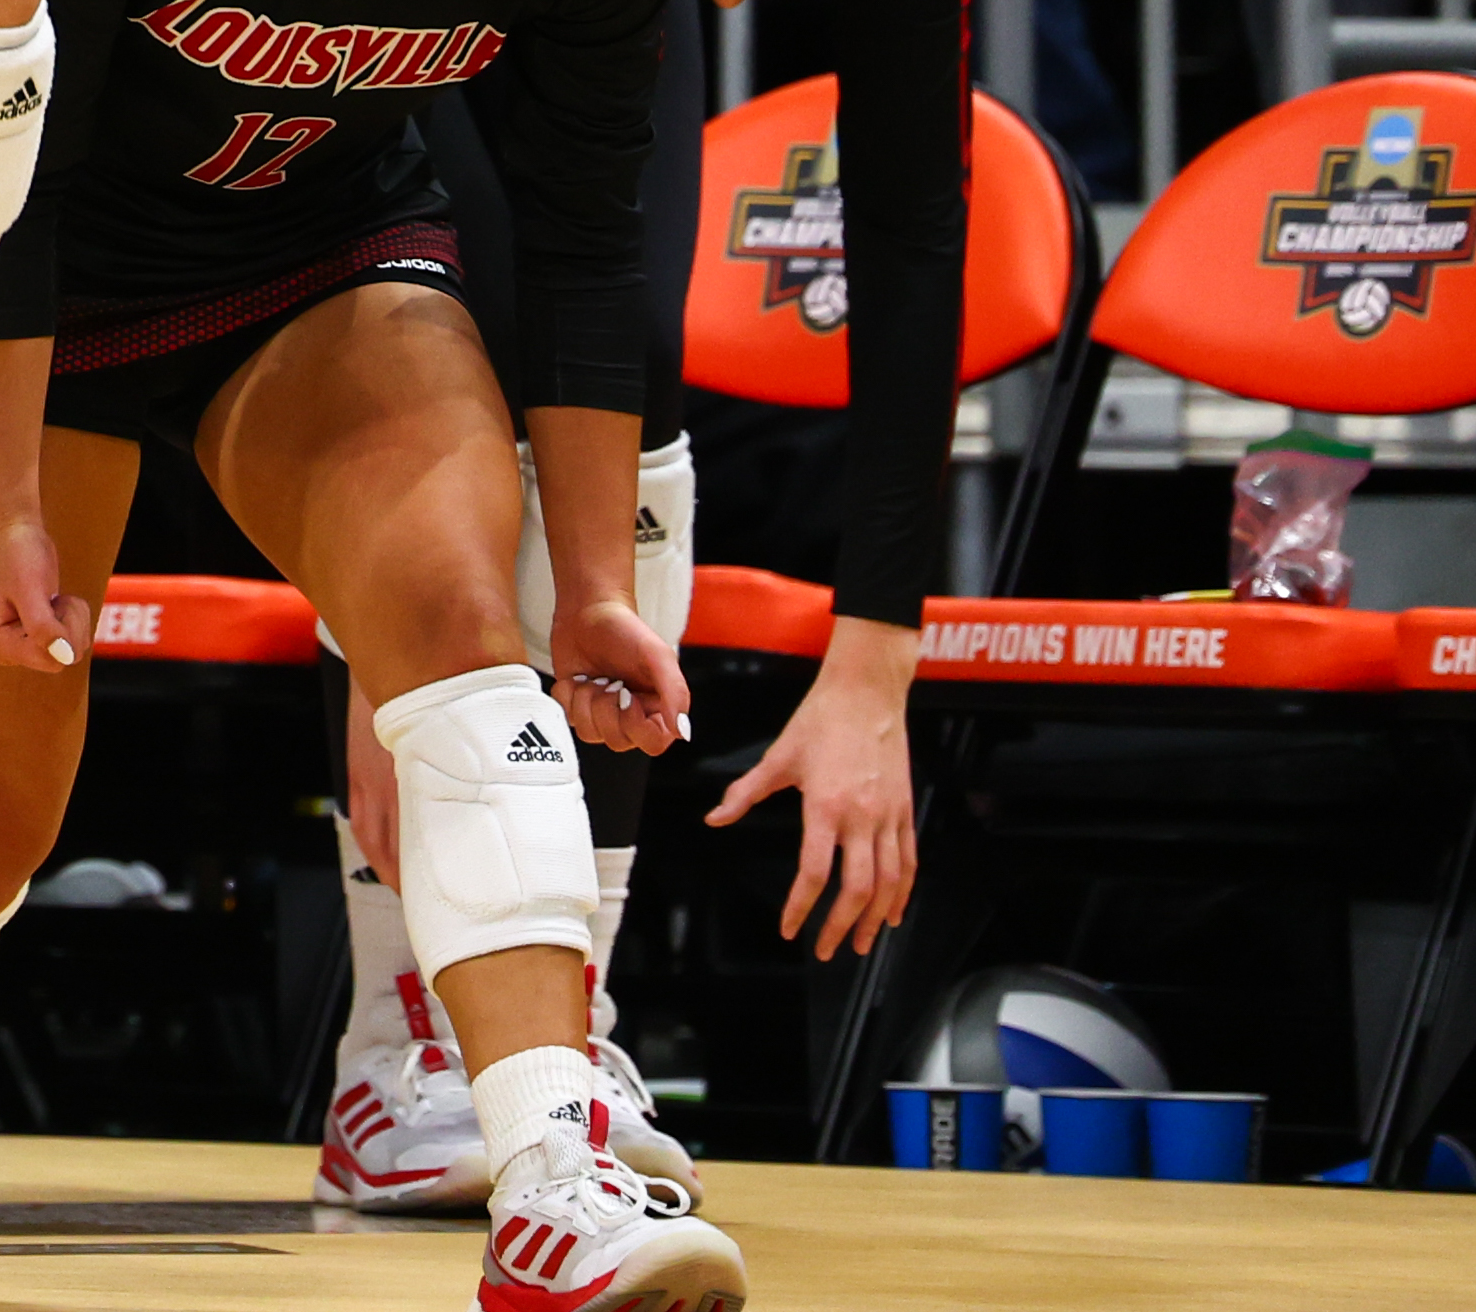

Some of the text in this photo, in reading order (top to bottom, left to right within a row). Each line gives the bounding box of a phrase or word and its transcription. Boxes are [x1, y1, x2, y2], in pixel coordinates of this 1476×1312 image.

[184, 112, 337, 190] 12
[1276, 221, 1469, 253] CHAMPIONSHIP
[1073, 625, 1138, 666] WIN
[1143, 628, 1228, 668] HERE
[507, 746, 563, 763] adidas
